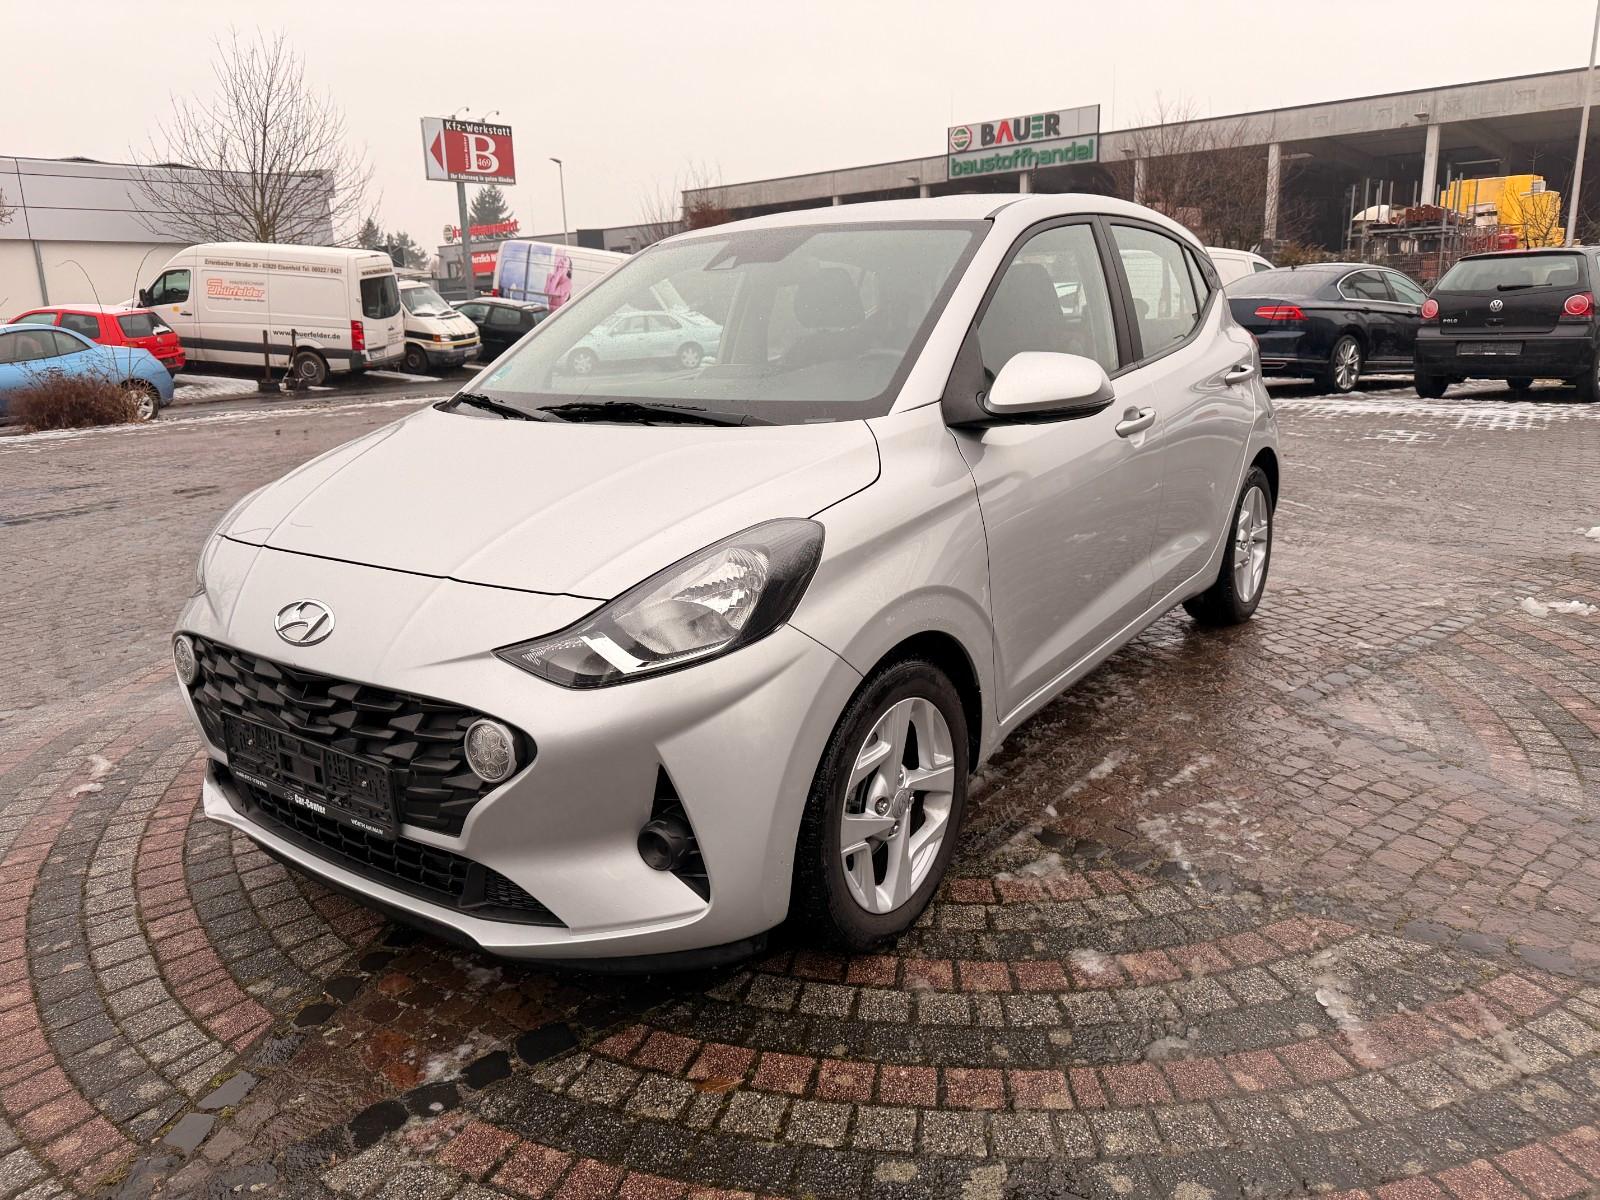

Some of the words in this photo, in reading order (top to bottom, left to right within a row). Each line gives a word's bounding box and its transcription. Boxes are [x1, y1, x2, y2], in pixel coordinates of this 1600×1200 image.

[445, 121, 510, 136] Kfz-Werkstatt
[980, 113, 1061, 146] BAUER
[462, 133, 499, 173] B
[478, 158, 492, 167] 469
[951, 138, 1094, 176] baustoffhandel
[272, 330, 341, 339] www.huerfelder.de
[294, 793, 326, 815] Car-Center
